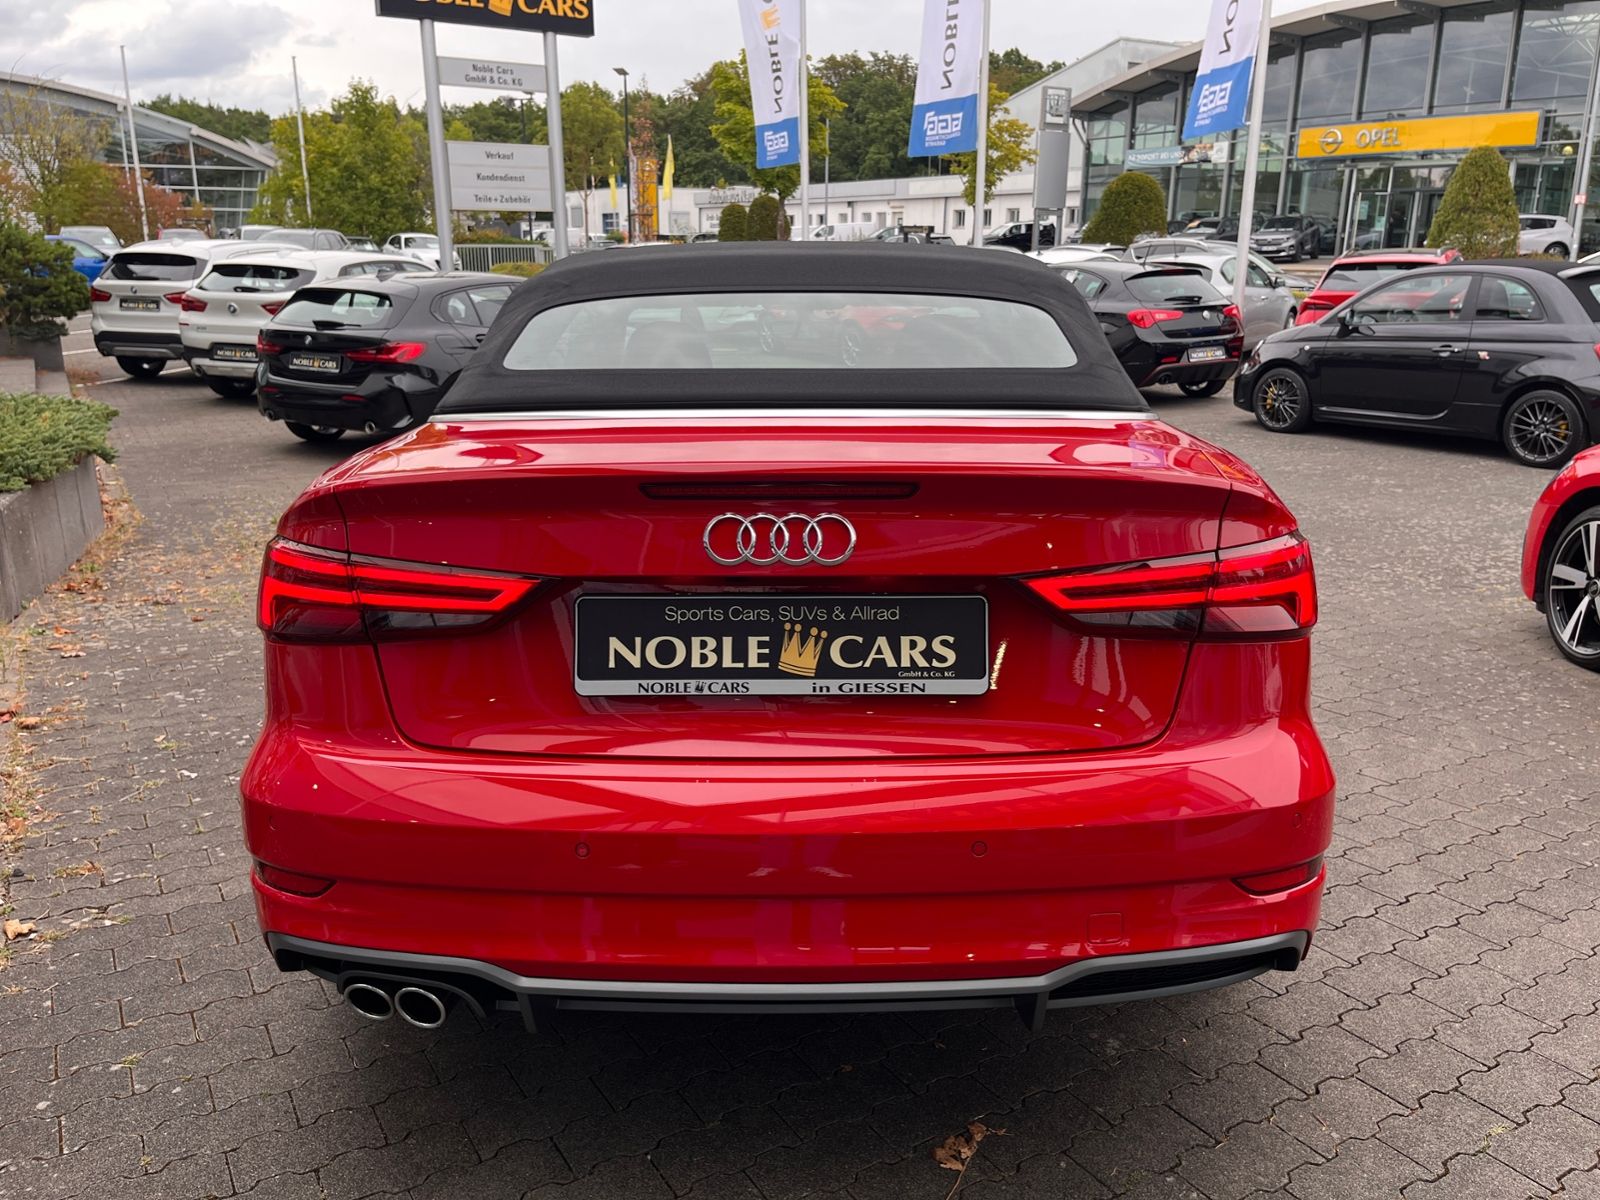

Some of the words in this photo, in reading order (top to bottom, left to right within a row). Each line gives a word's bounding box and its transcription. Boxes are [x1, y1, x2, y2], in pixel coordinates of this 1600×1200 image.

[517, 0, 590, 19] CARS
[472, 63, 494, 74] Noble
[496, 65, 514, 75] Cars
[465, 73, 487, 84] GmbH
[511, 77, 523, 87] KG
[1356, 127, 1402, 149] OPEL
[484, 150, 514, 161] Verkauf
[476, 172, 526, 182] Kundendienst
[292, 357, 314, 367] NOBLE
[319, 360, 337, 369] CARS
[664, 605, 724, 624] Sports
[728, 605, 775, 623] Cars,
[778, 605, 828, 621] SUVs
[832, 606, 846, 621] &
[850, 605, 900, 621] Allrad
[608, 636, 770, 669] NOBLE
[829, 635, 957, 669] CARS
[898, 670, 921, 678] GmbH
[930, 670, 943, 678] Co.
[944, 670, 956, 678] KG
[638, 681, 692, 694] NOBLE
[708, 681, 750, 694] CARS
[811, 682, 834, 694] in
[838, 682, 926, 694] GIESSEN
